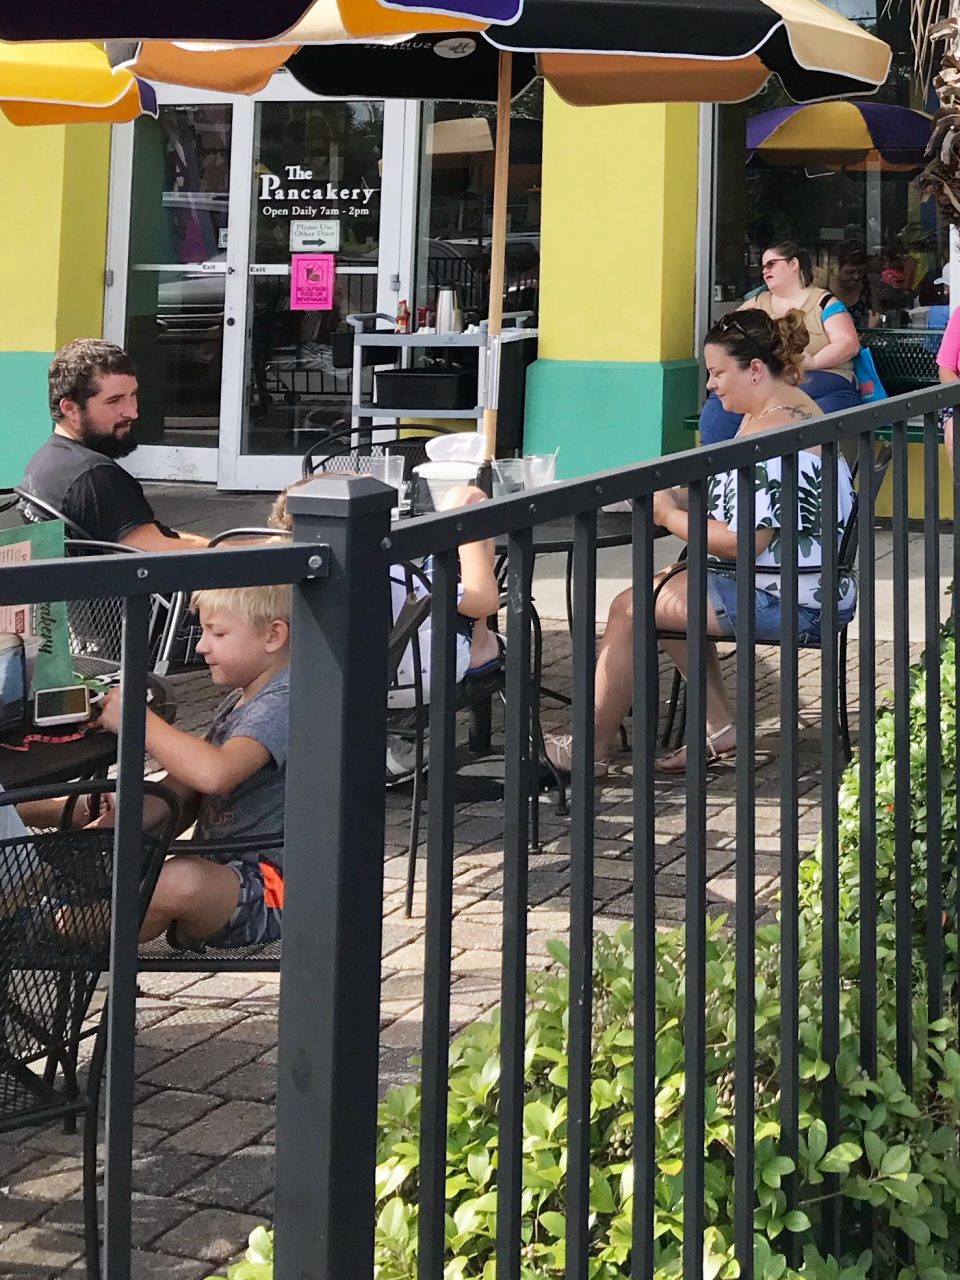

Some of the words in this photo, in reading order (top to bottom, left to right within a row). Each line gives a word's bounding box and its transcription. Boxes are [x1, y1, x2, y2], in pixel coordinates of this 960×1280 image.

[284, 164, 313, 180] The
[258, 173, 375, 205] Pancakery
[262, 205, 289, 218] Open
[291, 205, 318, 218] Daily
[319, 206, 340, 216] 7am
[348, 206, 370, 218] 2pm
